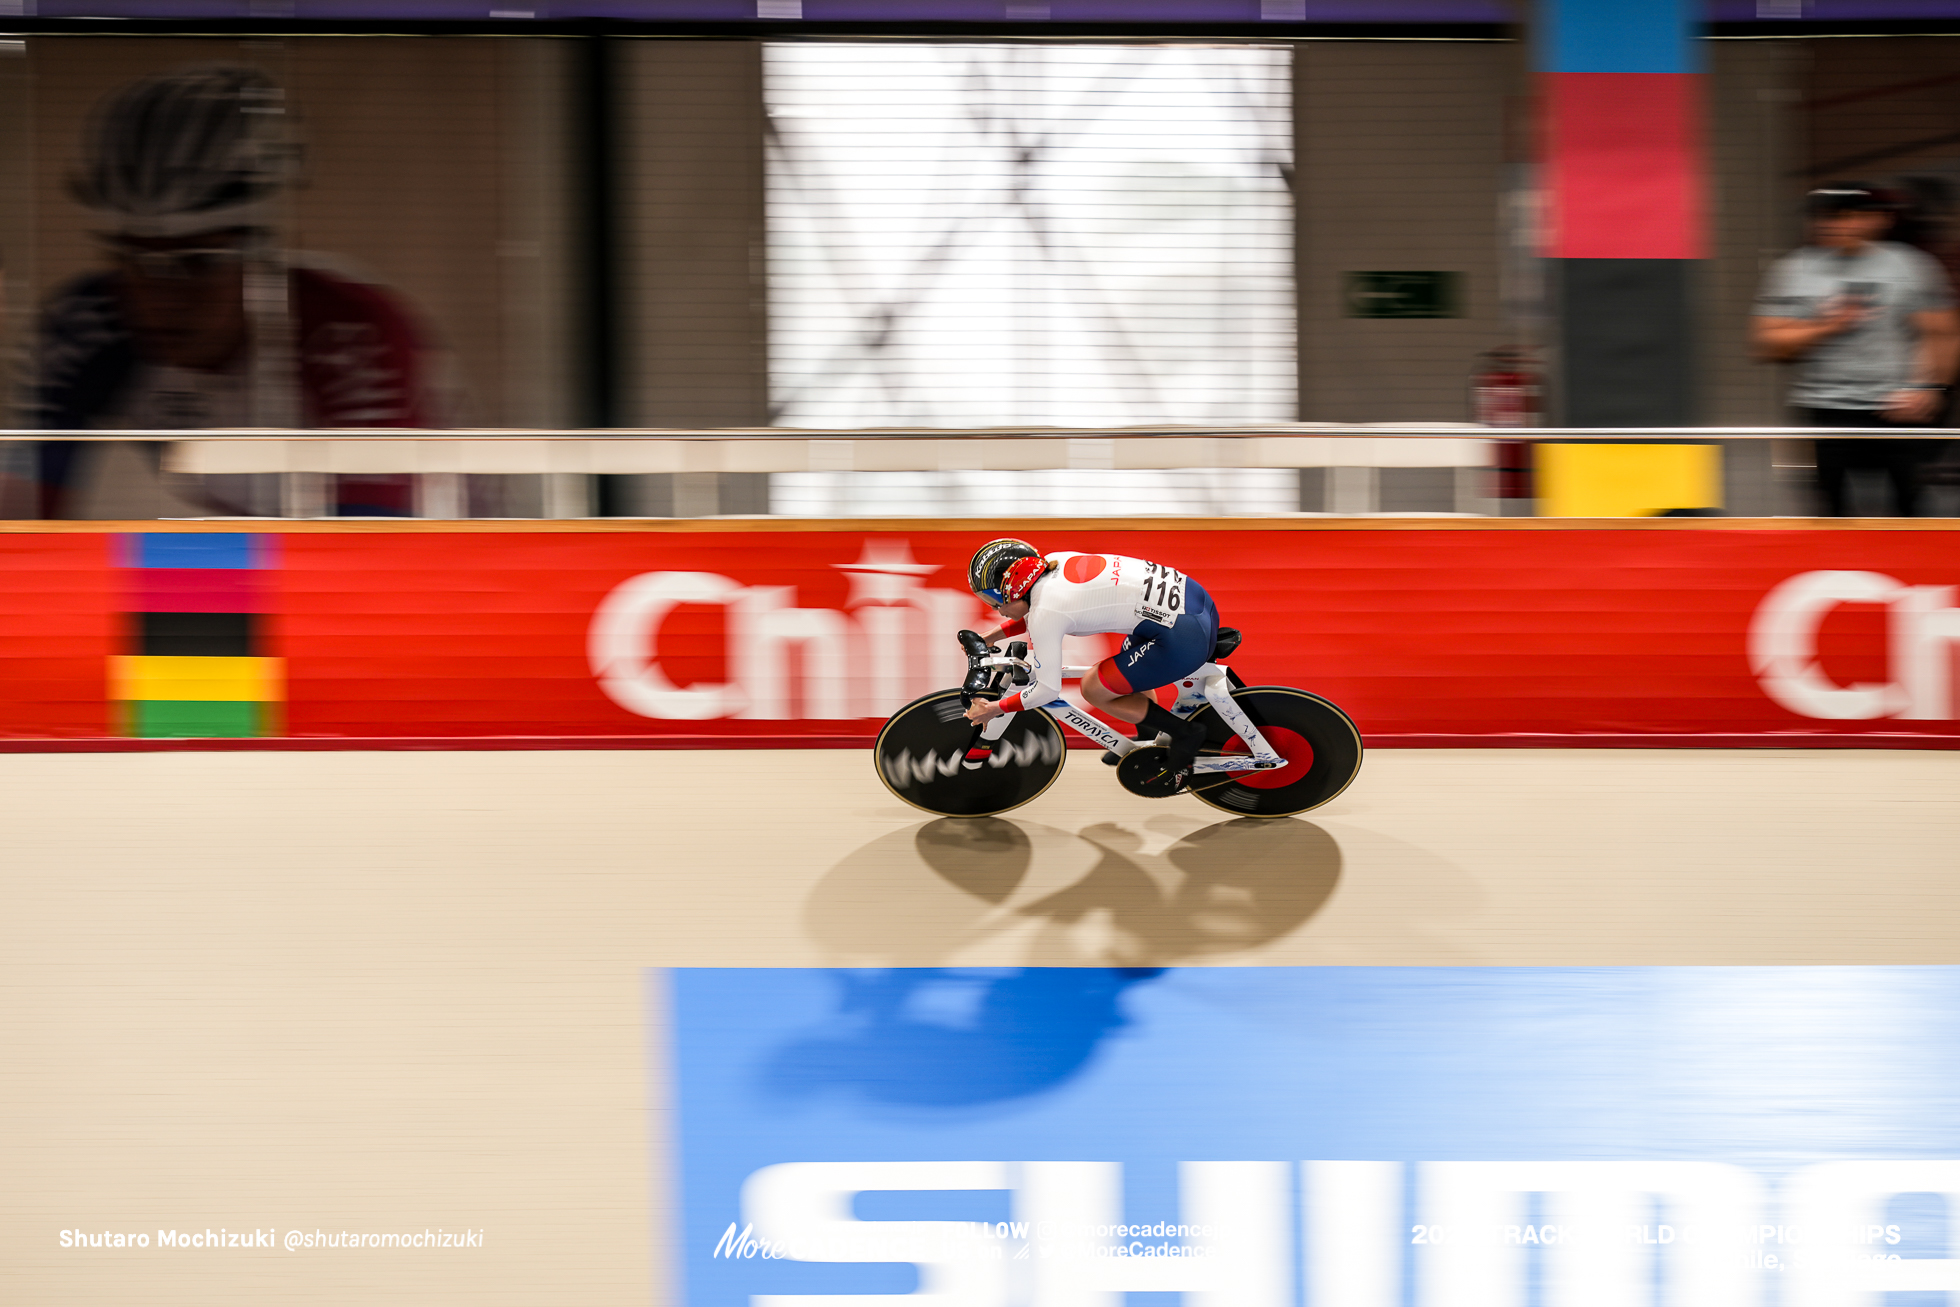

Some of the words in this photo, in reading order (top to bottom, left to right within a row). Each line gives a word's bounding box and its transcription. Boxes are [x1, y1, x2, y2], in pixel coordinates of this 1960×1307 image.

[1018, 558, 1044, 592] JAPAN
[1110, 556, 1121, 586] JAPA
[1143, 576, 1181, 611] 116
[586, 540, 1080, 721] Chil
[1127, 639, 1156, 667] JAPA
[1064, 711, 1119, 747] TORAYCA
